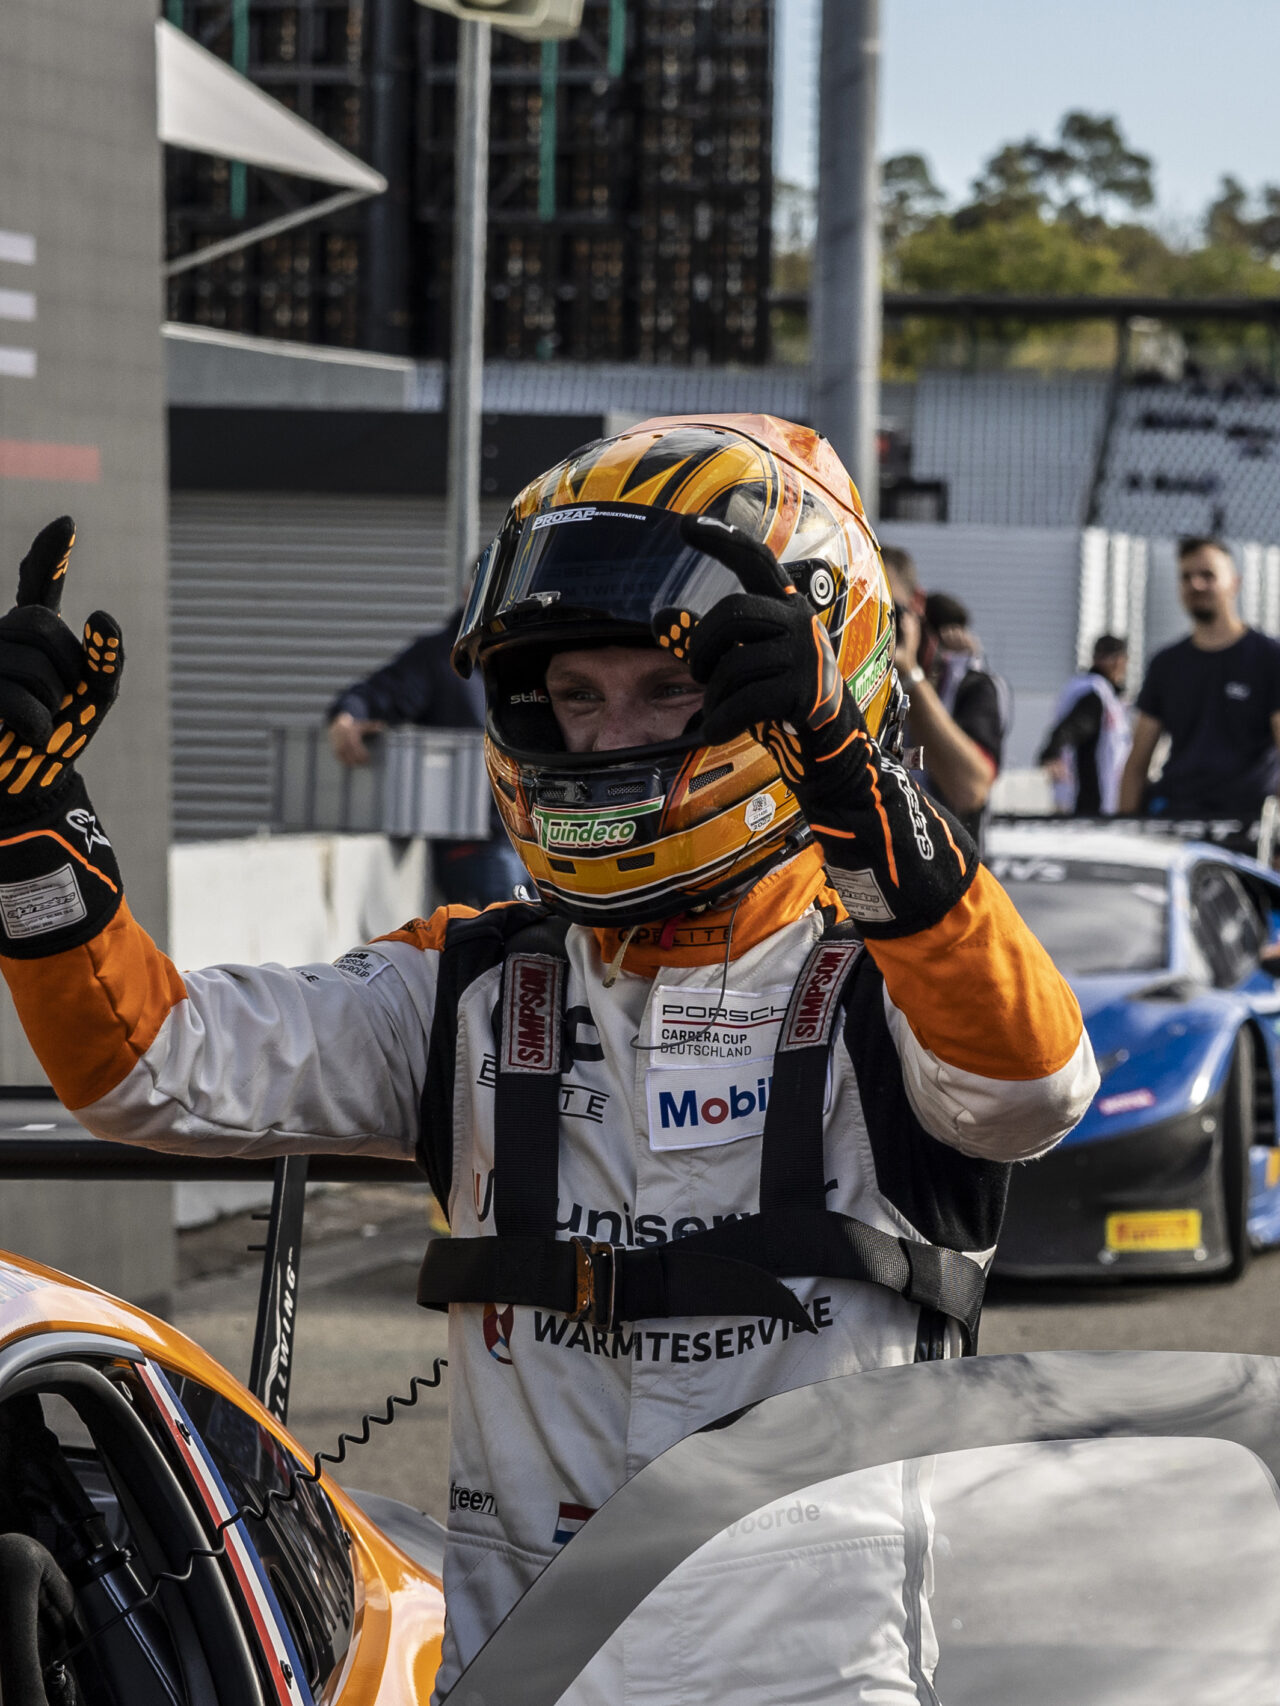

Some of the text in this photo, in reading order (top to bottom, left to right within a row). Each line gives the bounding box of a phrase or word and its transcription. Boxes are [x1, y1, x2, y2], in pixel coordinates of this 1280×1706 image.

[533, 509, 595, 530] PROZAP
[531, 806, 652, 850] Tuindeco
[517, 966, 548, 1064] SIMPSON
[662, 1004, 788, 1022] PORSCH
[794, 952, 846, 1038] SIMPSON
[660, 1042, 752, 1058] DEUTSCHLAND
[661, 1028, 748, 1045] CARRERA CUP
[477, 1058, 608, 1119] ETE
[534, 1296, 834, 1363] WARMTESERVIE
